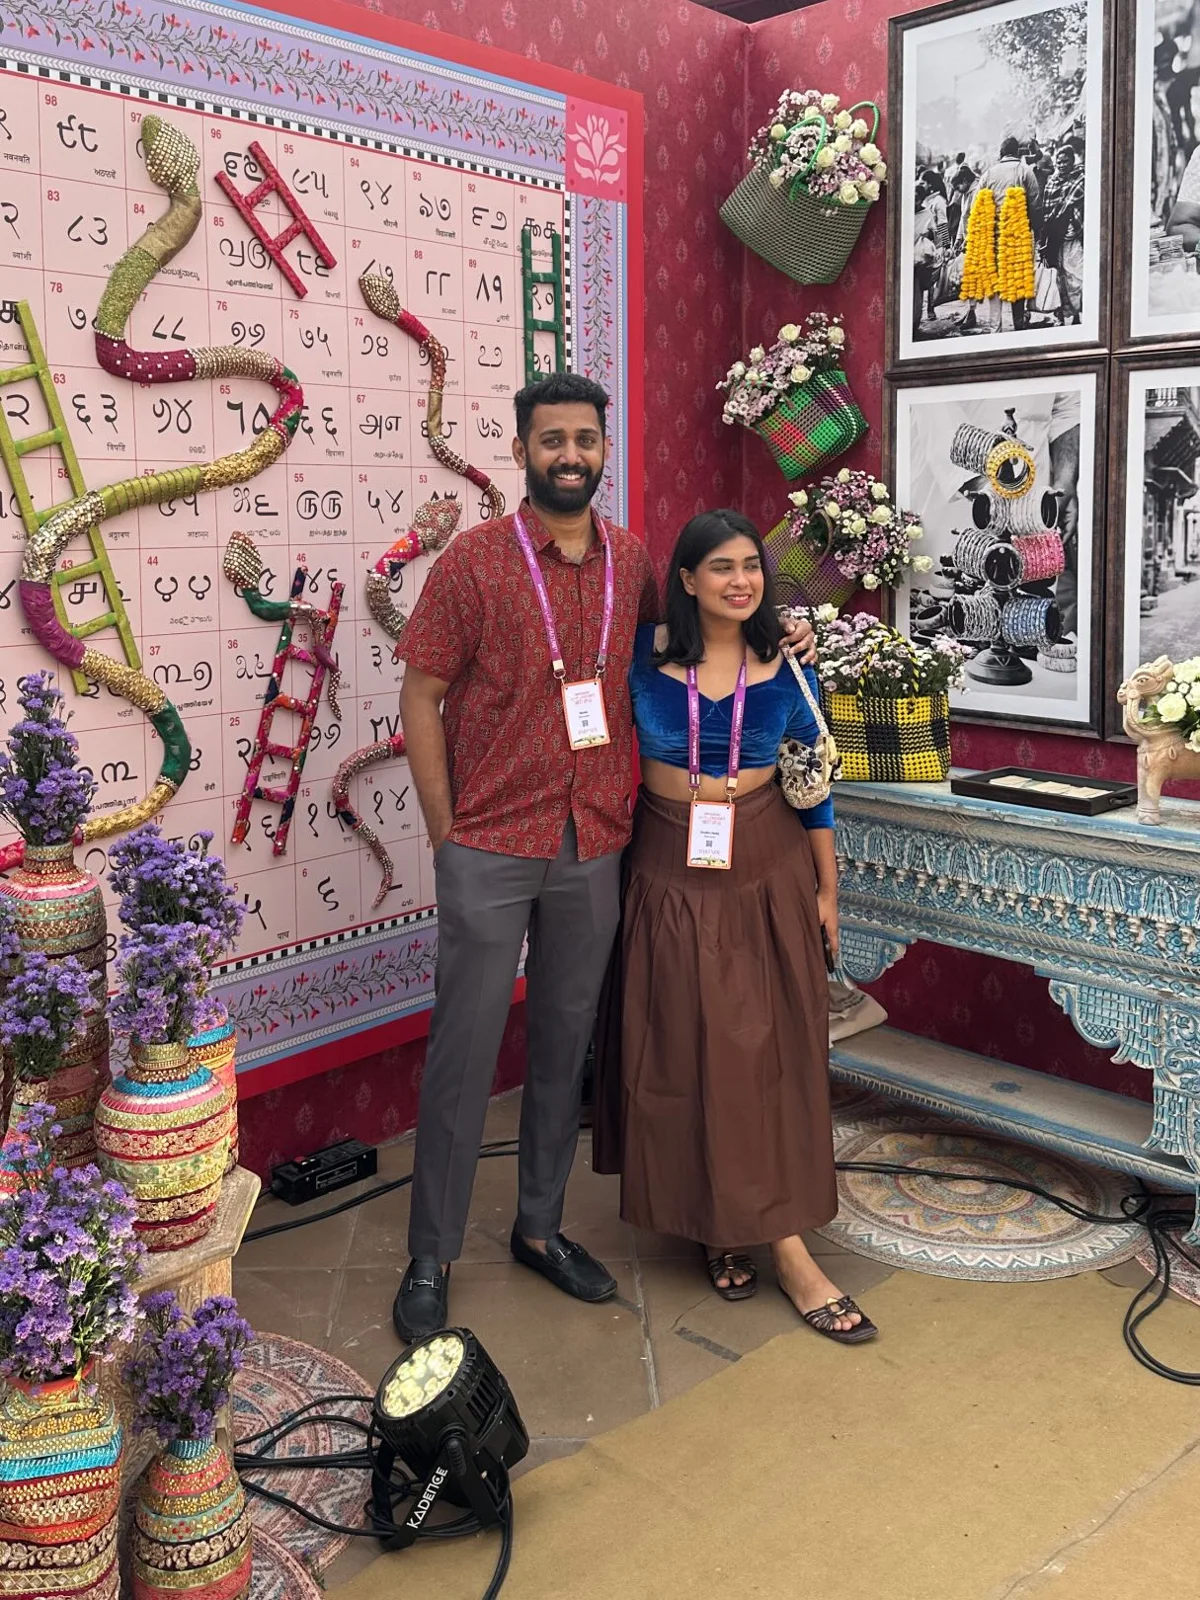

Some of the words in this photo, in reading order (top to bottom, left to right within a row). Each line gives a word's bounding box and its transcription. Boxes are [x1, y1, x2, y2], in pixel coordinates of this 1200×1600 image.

[44, 93, 57, 106] 98
[130, 111, 142, 122] 97
[210, 128, 222, 139] 96
[283, 143, 294, 154] 95
[349, 157, 360, 168] 94
[412, 171, 422, 182] 93
[467, 182, 476, 193] 92
[47, 189, 60, 201] 83
[133, 203, 145, 214] 84
[213, 216, 225, 228] 85
[352, 239, 361, 249] 87
[414, 250, 423, 260] 88
[468, 258, 477, 269] 89
[50, 281, 63, 293] 78
[216, 300, 228, 311] 76
[289, 309, 300, 320] 75
[354, 317, 364, 326] 74
[469, 330, 478, 340] 72
[53, 373, 66, 384] 63
[219, 384, 231, 395] 65
[356, 394, 366, 404] 67
[417, 399, 426, 408] 68
[471, 402, 480, 411] 69
[72, 393, 119, 435] ६३
[294, 473, 304, 483] 55
[358, 473, 368, 483] 54
[419, 475, 428, 483] 53
[147, 555, 158, 566] 44
[296, 553, 306, 562] 46
[360, 551, 369, 560] 47
[298, 633, 307, 642] 35
[362, 628, 371, 637] 34
[227, 639, 238, 649] 36
[149, 645, 161, 656] 37
[363, 701, 372, 710] 27
[229, 717, 240, 726] 25
[364, 776, 373, 785] 14
[301, 788, 310, 797] 15
[153, 815, 164, 826] 17
[366, 853, 371, 863] 7
[302, 868, 308, 878] 6
[233, 882, 239, 892] 5
[406, 1466, 448, 1529] KADENCE
